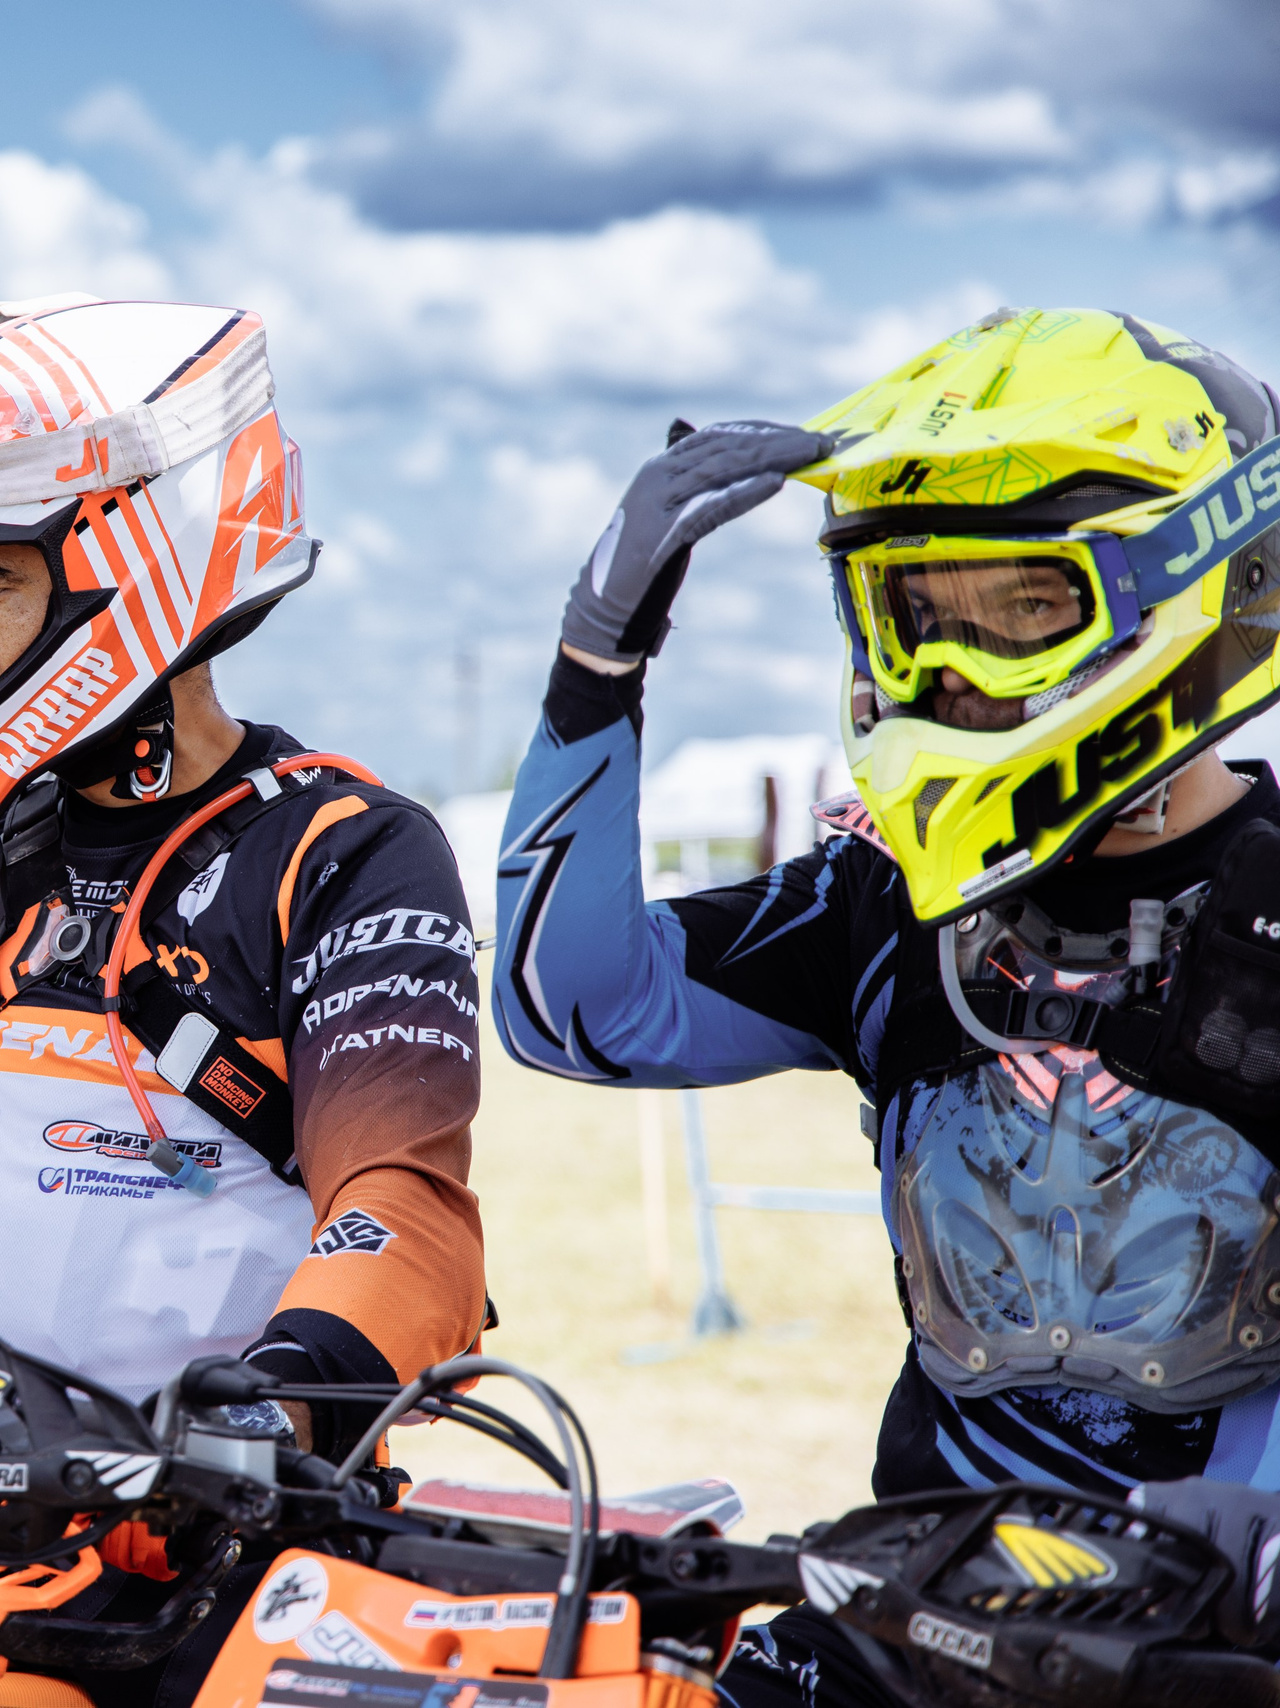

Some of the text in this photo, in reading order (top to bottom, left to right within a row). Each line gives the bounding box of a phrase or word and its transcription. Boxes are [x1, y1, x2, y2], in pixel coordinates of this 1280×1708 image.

[919, 391, 967, 437] JUST1
[215, 1062, 234, 1077] NO
[206, 1077, 249, 1111] MONKEY
[210, 1070, 254, 1106] DANCING
[71, 1186, 155, 1200] ПРИКАМЬЕ
[907, 1611, 994, 1669] CYCRA
